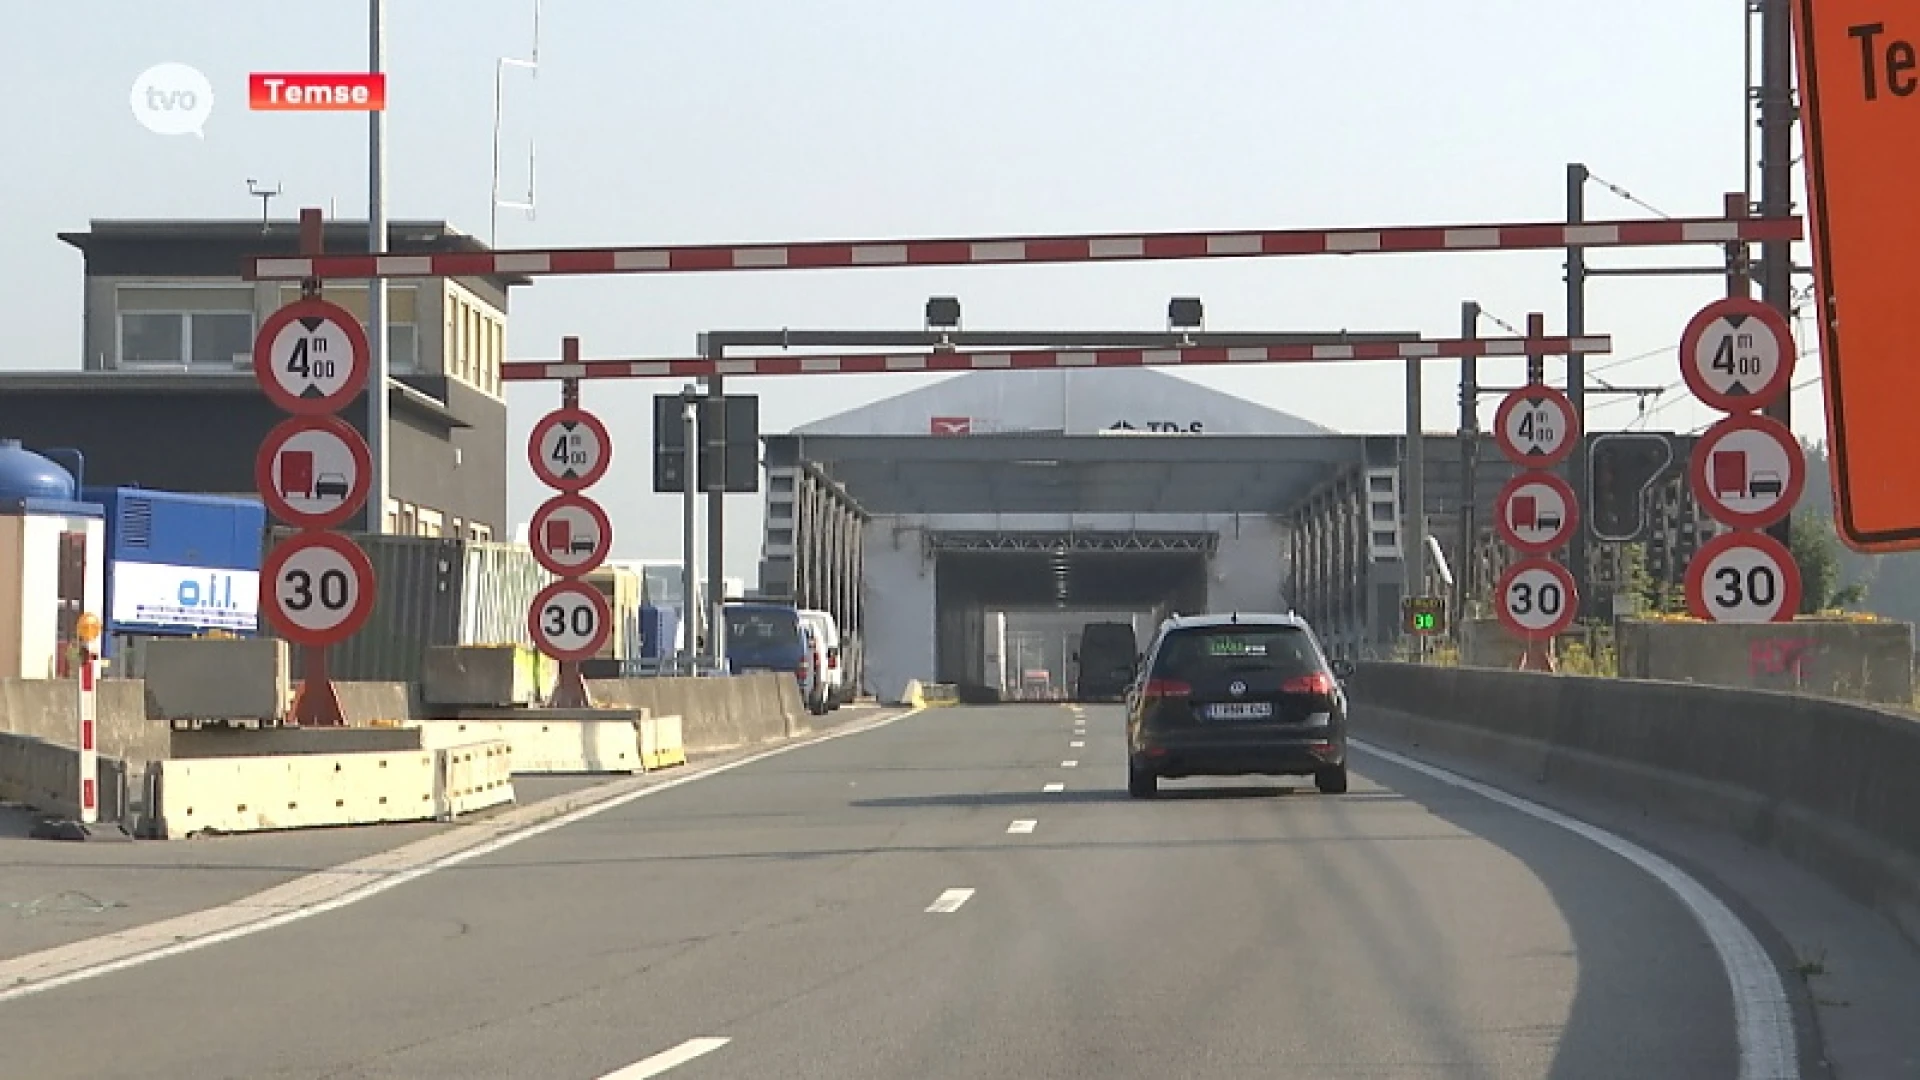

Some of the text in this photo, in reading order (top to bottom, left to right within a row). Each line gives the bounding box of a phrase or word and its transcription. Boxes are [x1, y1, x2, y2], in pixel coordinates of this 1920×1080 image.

[1847, 21, 1918, 102] Te
[286, 337, 310, 378] 4
[1712, 333, 1736, 375] 4
[284, 568, 349, 611] 30
[1511, 582, 1560, 615] 30
[1714, 565, 1775, 608] 30
[544, 604, 594, 637] 30
